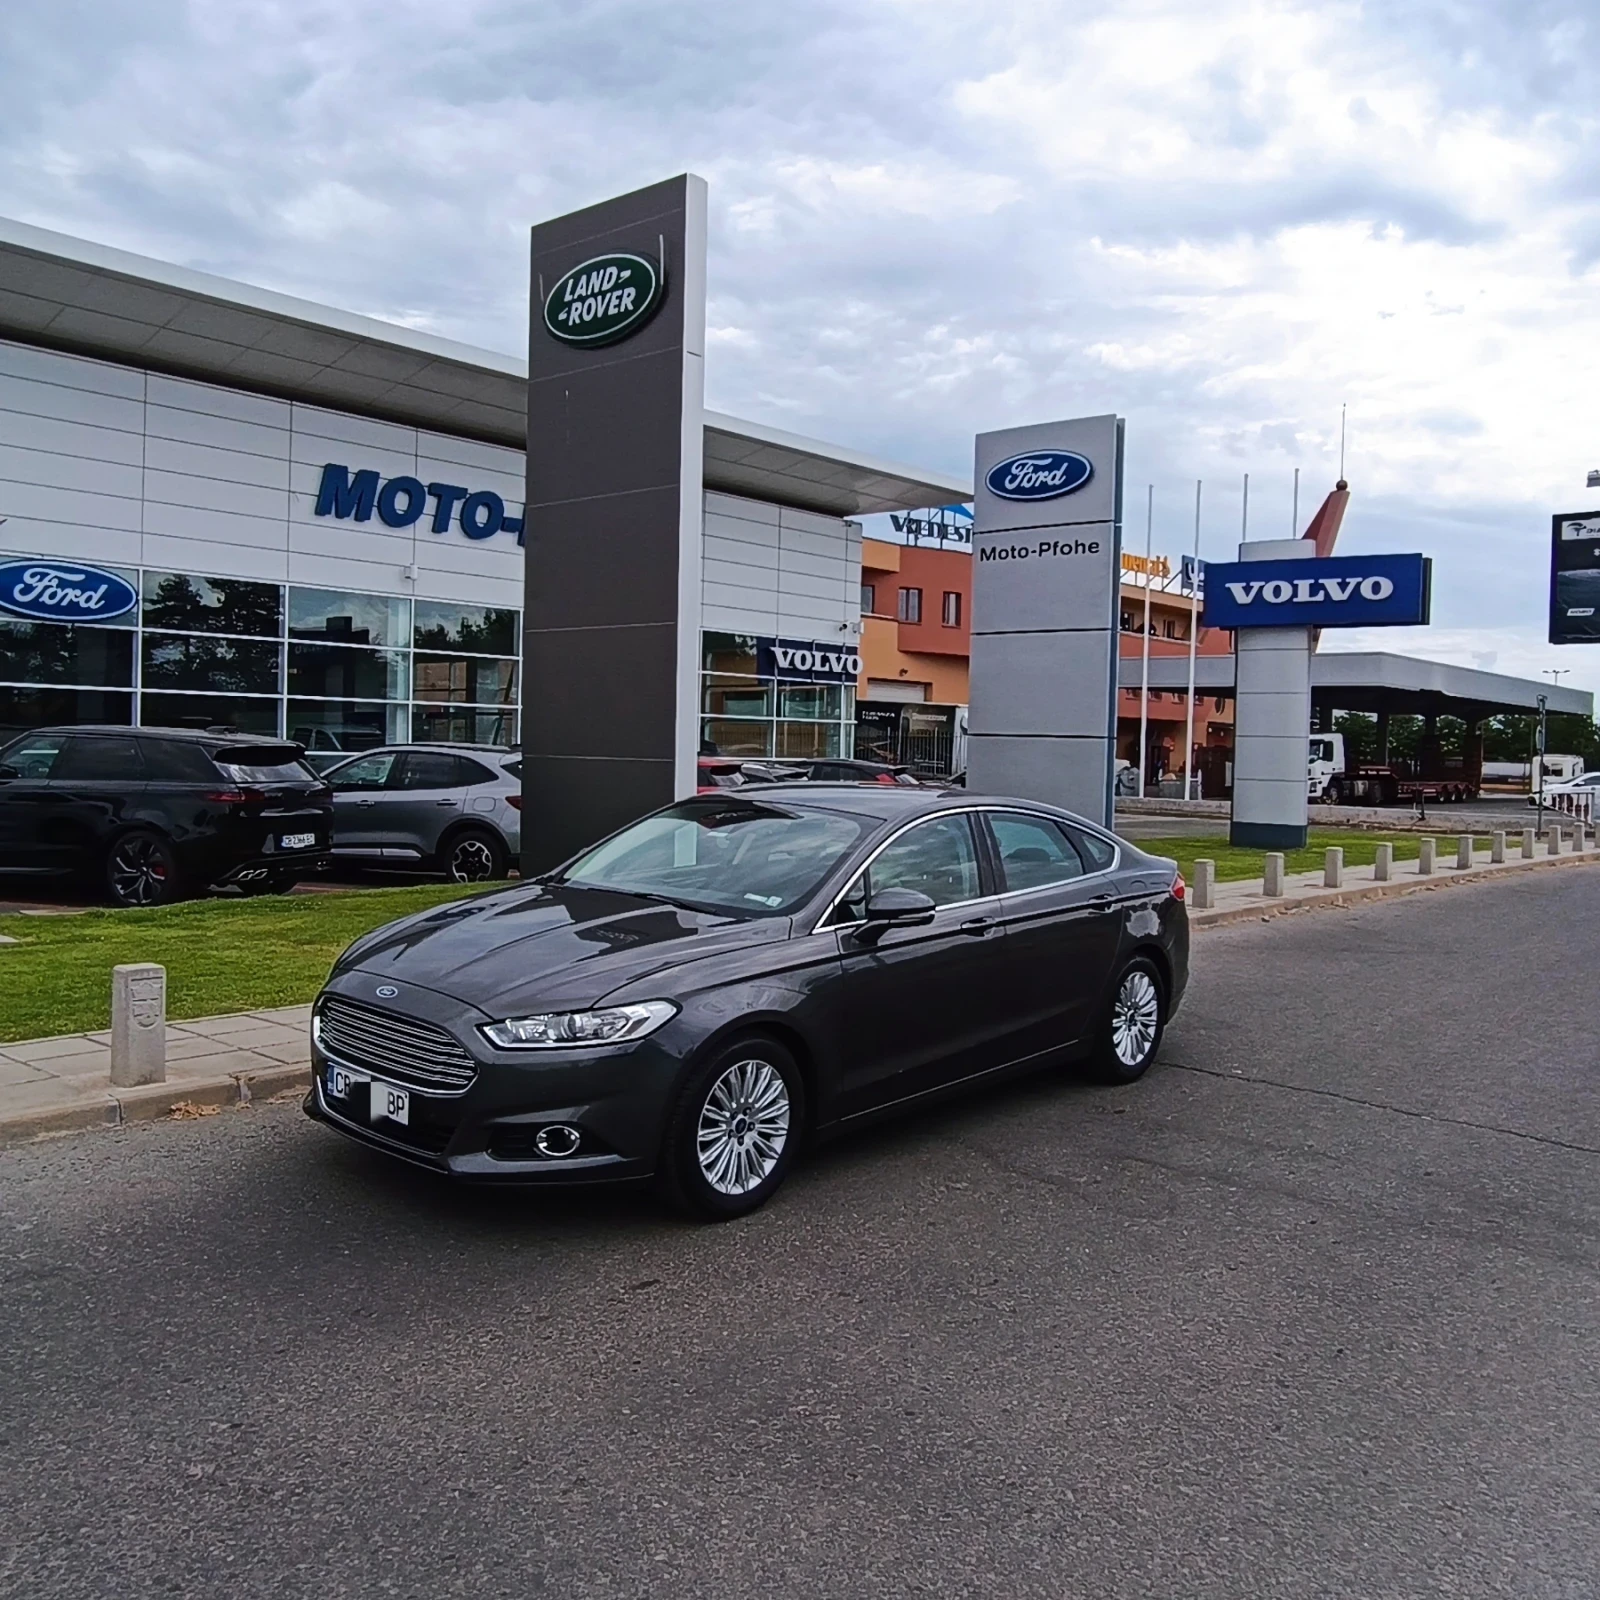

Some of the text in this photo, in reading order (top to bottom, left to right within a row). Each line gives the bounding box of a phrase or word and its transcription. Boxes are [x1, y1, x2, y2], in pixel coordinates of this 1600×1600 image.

[1004, 458, 1069, 490] Ford
[314, 463, 525, 548] MOTO-
[980, 540, 1100, 562] Moto-Pfohe
[13, 567, 109, 610] Ford
[1224, 576, 1394, 605] VOLVO
[769, 646, 864, 675] VOLVO
[387, 1090, 406, 1118] BP
